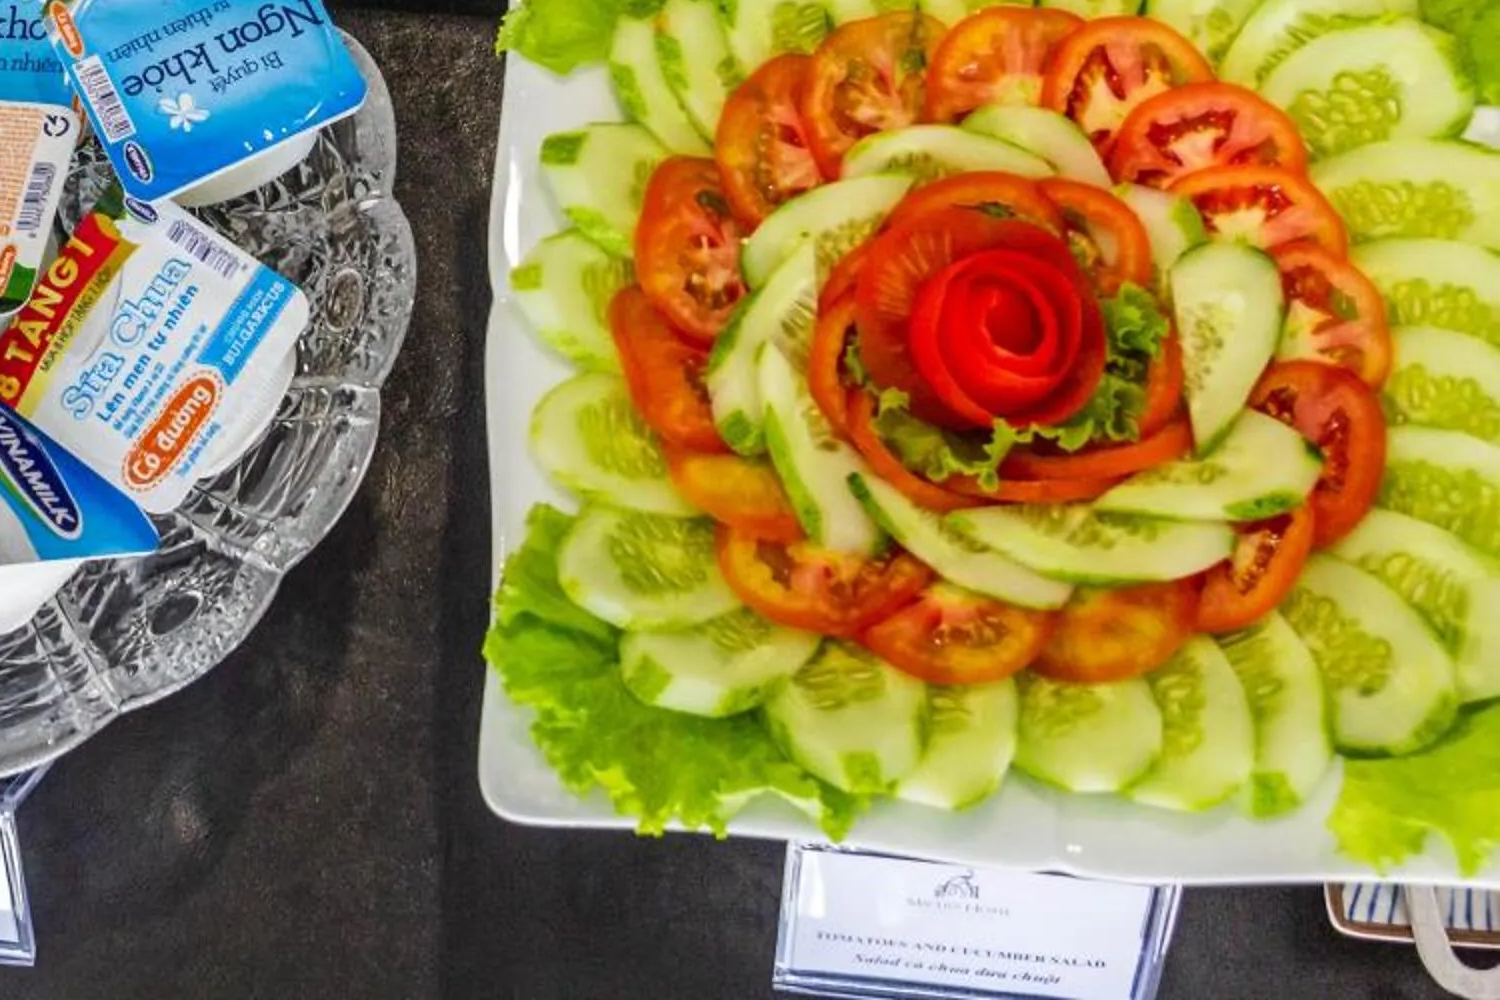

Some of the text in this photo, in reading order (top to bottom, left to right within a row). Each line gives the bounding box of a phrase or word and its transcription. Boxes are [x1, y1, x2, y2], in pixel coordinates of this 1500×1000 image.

[108, 31, 160, 63] nhiên
[164, 7, 213, 37] thiên
[122, 43, 219, 96] khỏe
[209, 51, 284, 93] Bí quyết
[4, 259, 80, 366] TẶNG
[71, 236, 96, 258] 1
[222, 281, 286, 367] BULGARICUS
[63, 351, 126, 422] Sữa
[110, 257, 193, 348] Chua
[96, 284, 199, 423] Lên men tự nhiên
[132, 446, 162, 482] Có
[158, 384, 214, 451] đường
[817, 931, 908, 947] TOMATOES
[915, 943, 947, 952] AND
[1050, 957, 1106, 968] SALAD
[855, 953, 901, 966] Salad
[928, 963, 970, 975] chua
